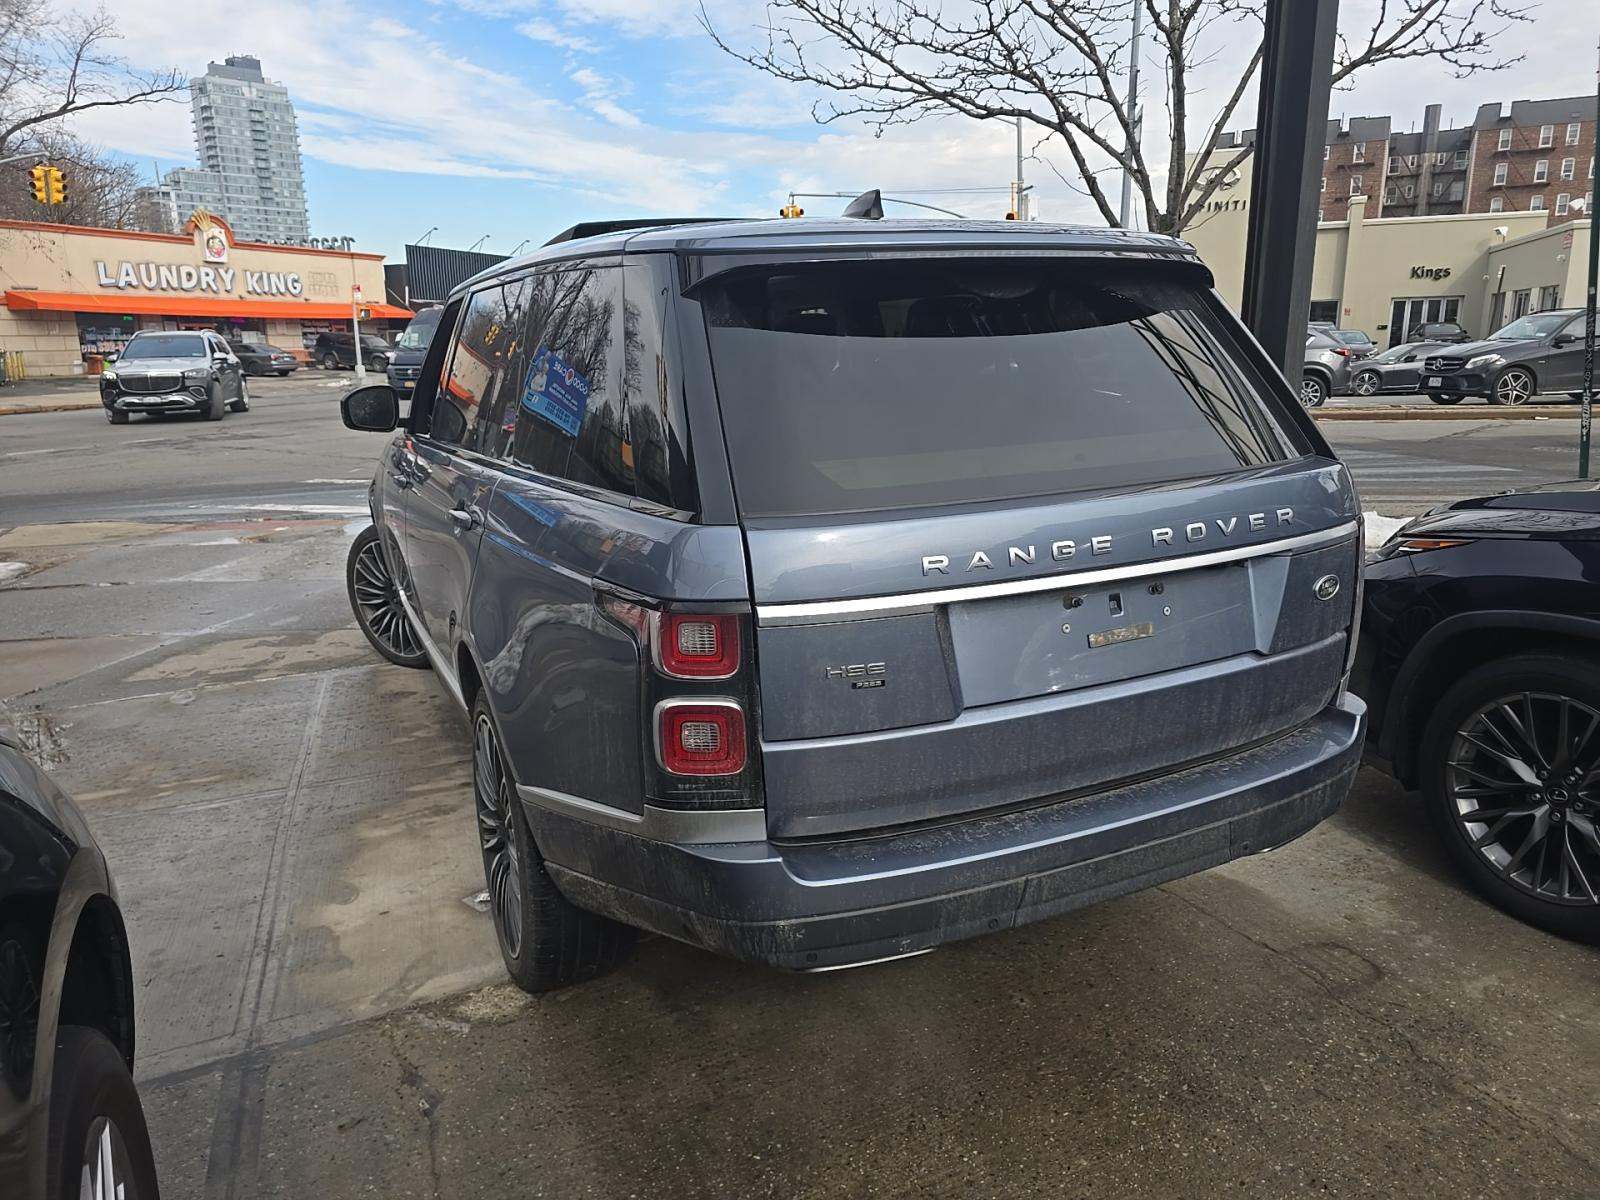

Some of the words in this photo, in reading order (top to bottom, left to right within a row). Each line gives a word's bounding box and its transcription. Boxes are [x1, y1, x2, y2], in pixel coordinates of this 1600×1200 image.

[95, 261, 236, 293] LAUNDRY
[245, 269, 303, 296] KING
[1409, 265, 1451, 281] Kings
[921, 534, 1113, 577] RANGE
[1151, 507, 1295, 548] ROVER
[825, 662, 886, 679] HSE
